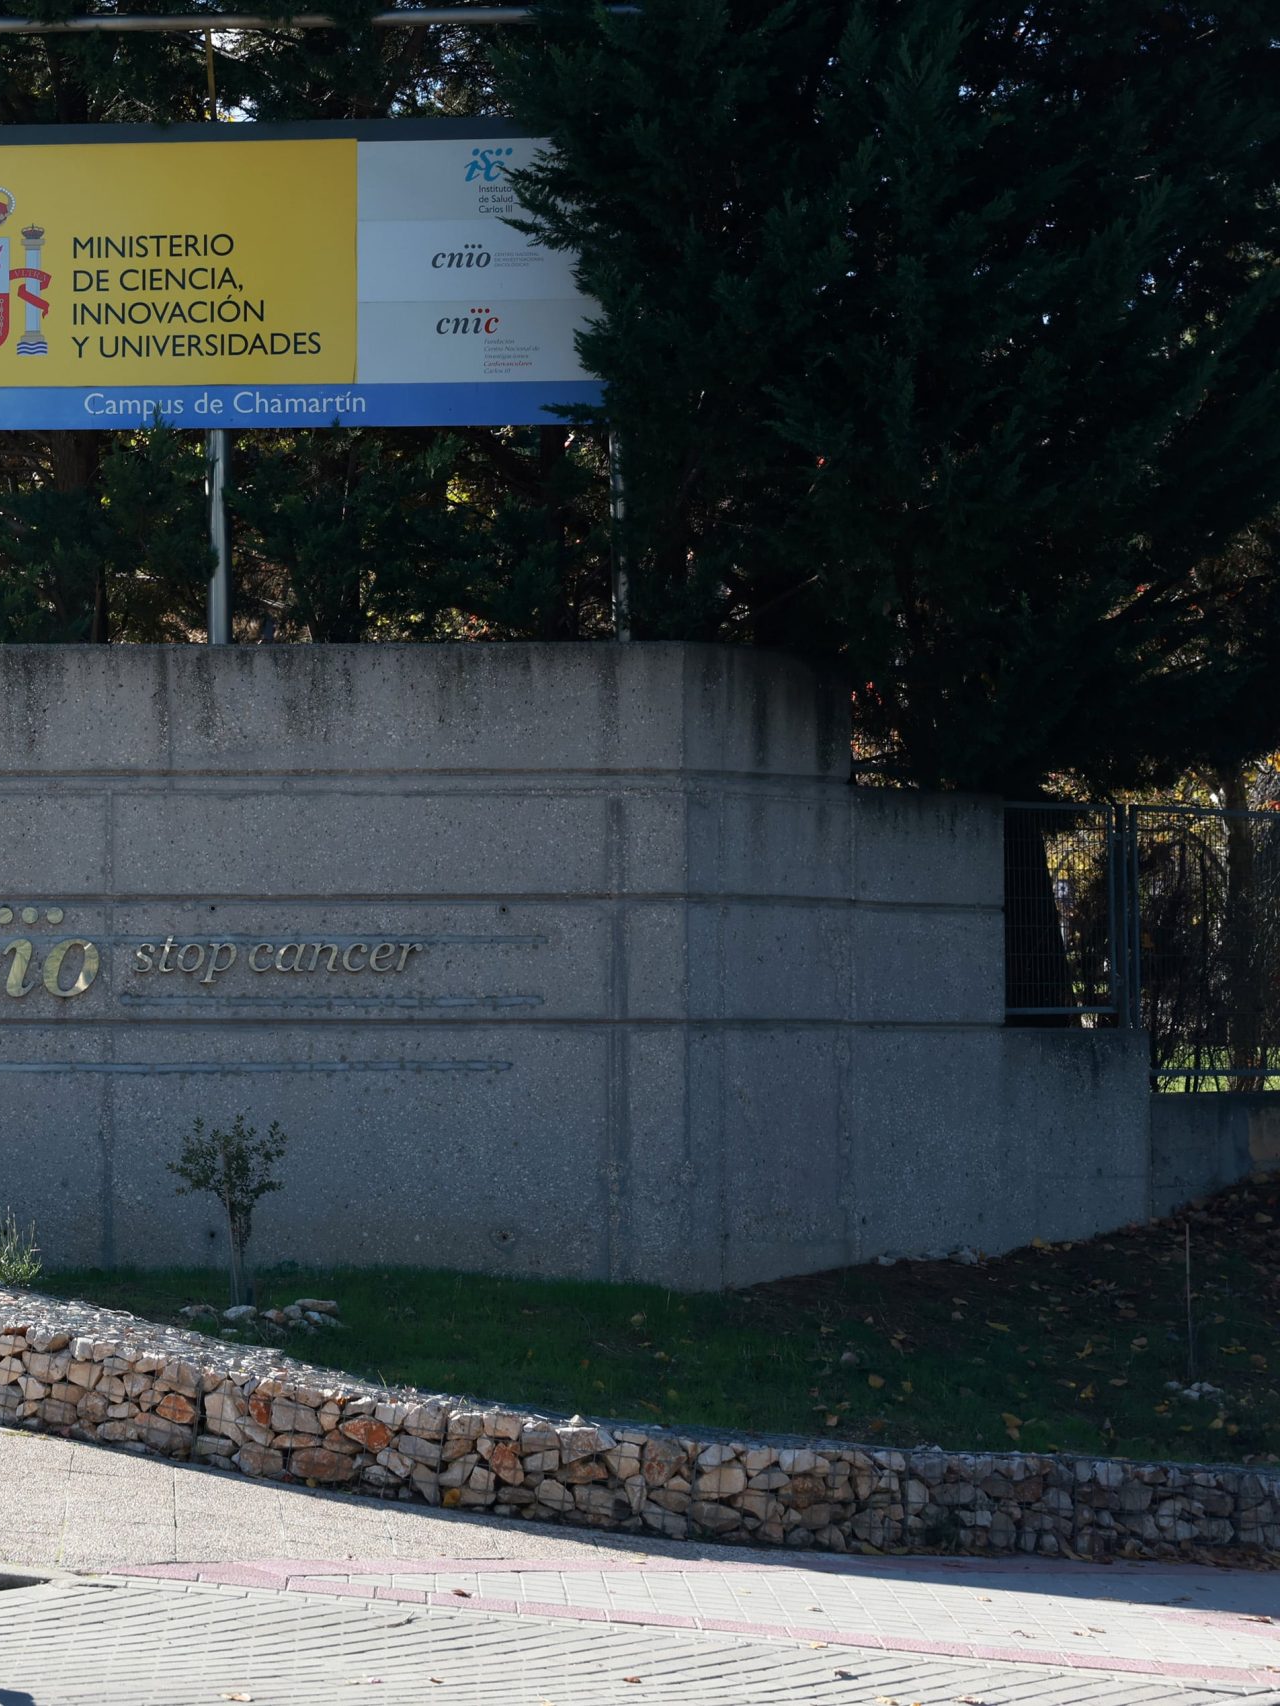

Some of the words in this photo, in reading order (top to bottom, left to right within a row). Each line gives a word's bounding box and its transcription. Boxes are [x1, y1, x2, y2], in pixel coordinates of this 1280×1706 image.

[478, 184, 513, 193] Instituto
[478, 195, 489, 203] de
[491, 194, 513, 203] Salud
[478, 205, 503, 214] Carlos
[505, 204, 513, 213] III
[73, 233, 234, 259] MINISTERIO
[73, 269, 110, 292] DE
[119, 267, 243, 292] CIENCIA,
[73, 294, 265, 325] INNOVACIÓN
[436, 308, 500, 335] cnic
[71, 336, 90, 358] Y
[99, 332, 321, 358] UNIVERSIDADES
[84, 392, 184, 421] Campus
[194, 391, 224, 414] de
[233, 390, 366, 414] Chamartín
[132, 935, 238, 983] stop
[248, 942, 424, 973] cancer
